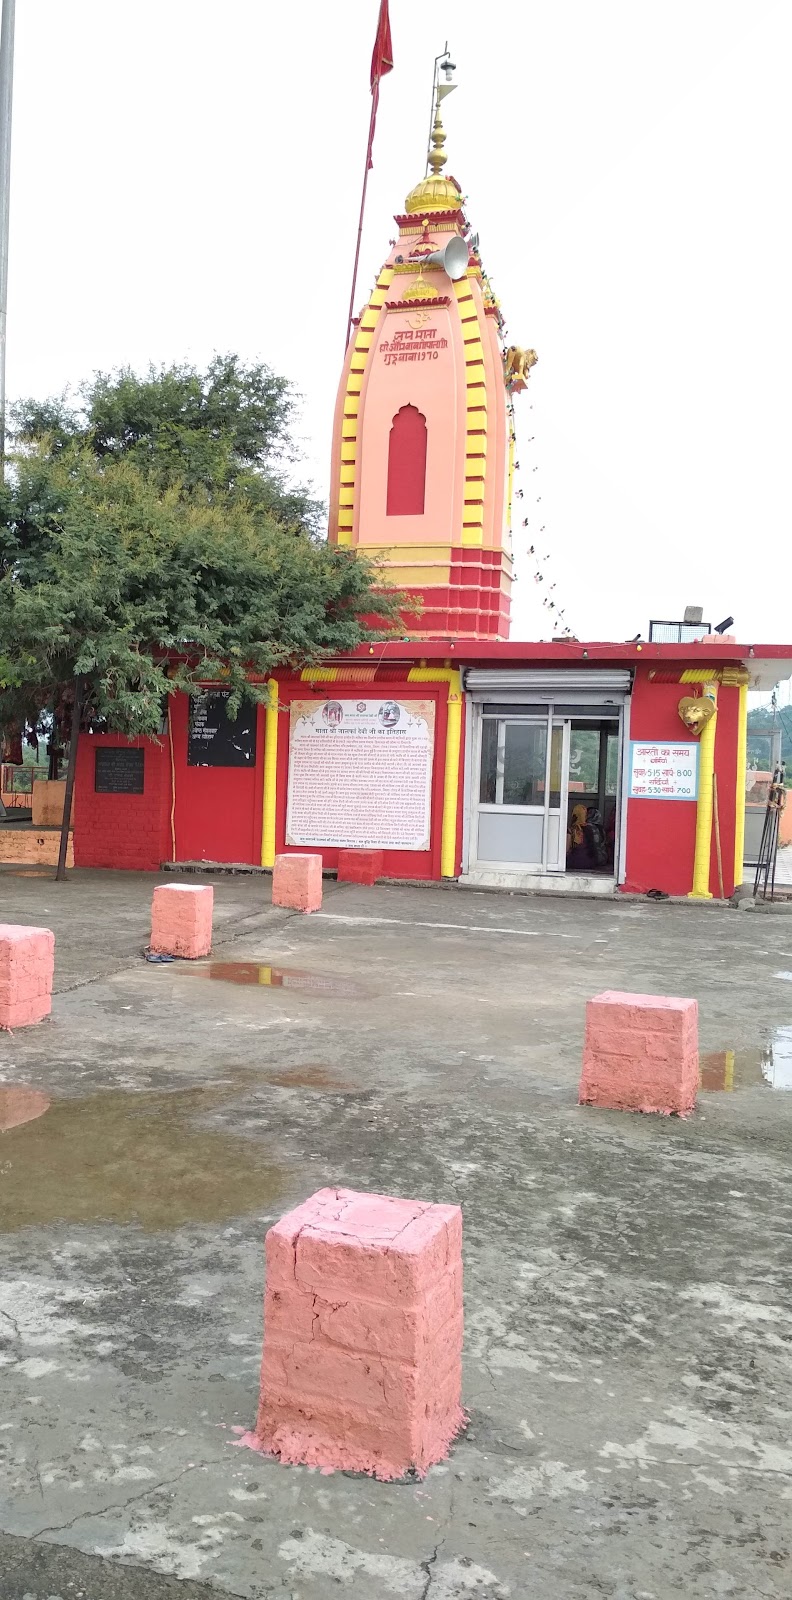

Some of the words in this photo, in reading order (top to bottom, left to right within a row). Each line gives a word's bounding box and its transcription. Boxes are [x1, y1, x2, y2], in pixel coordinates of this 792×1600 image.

[394, 331, 413, 341] जय
[415, 329, 437, 339] माता
[636, 746, 658, 756] आरती
[672, 749, 690, 757] समय
